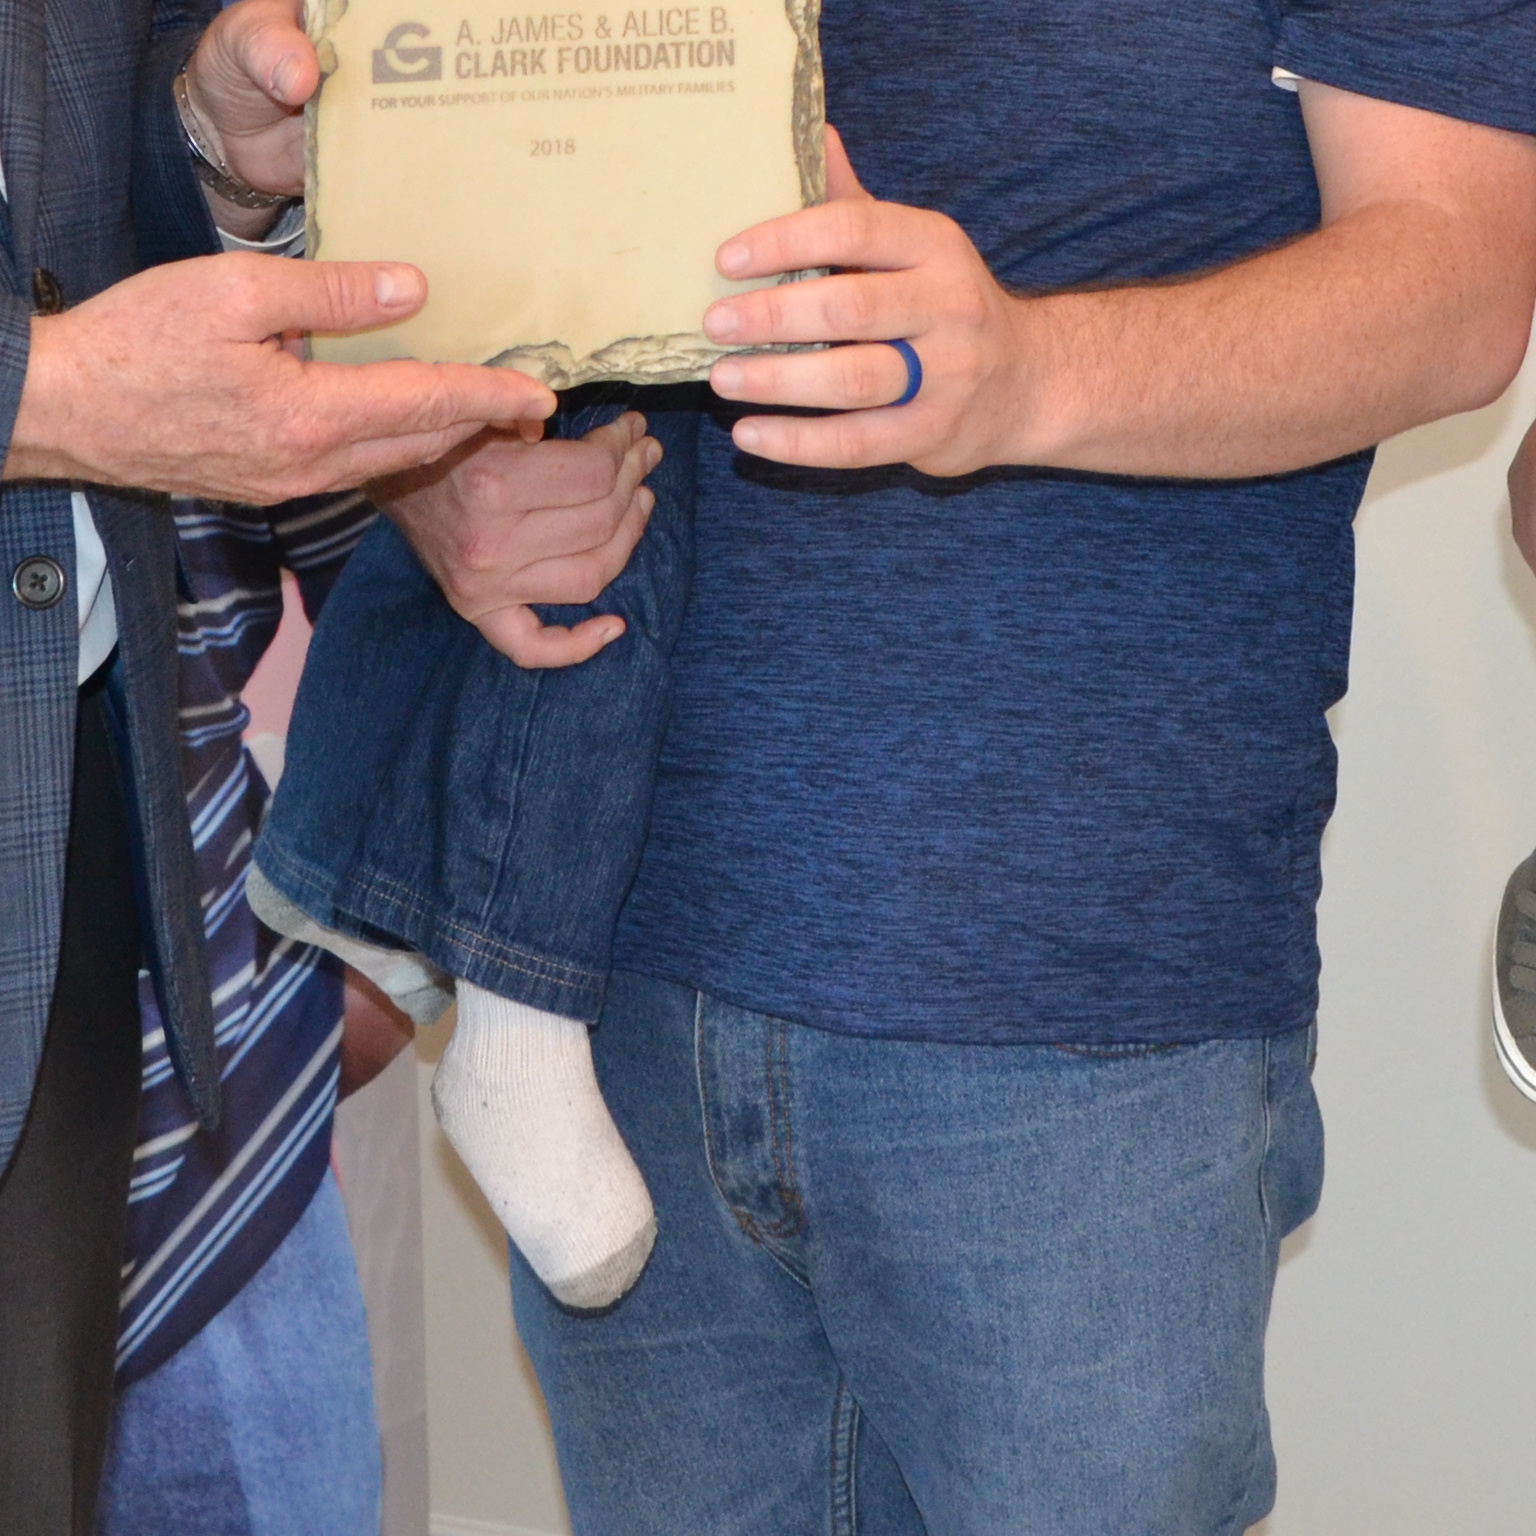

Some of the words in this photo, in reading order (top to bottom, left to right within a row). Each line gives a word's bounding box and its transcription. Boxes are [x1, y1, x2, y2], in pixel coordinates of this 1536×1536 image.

[456, 19, 481, 47] A.
[491, 13, 584, 45] JAMES
[594, 14, 612, 40] &
[622, 7, 700, 38] ALICE
[710, 6, 735, 35] B.
[455, 48, 547, 80] CLARK
[557, 39, 736, 74] FOUNDATION
[371, 97, 398, 110] FOR
[400, 95, 436, 109] YOUR
[438, 91, 496, 106] SUPPORT
[500, 90, 519, 104] OF
[552, 85, 613, 101] NATION'S
[616, 82, 676, 97] MILITARY
[678, 79, 736, 94] FAMILIES
[529, 140, 576, 157] 2018
